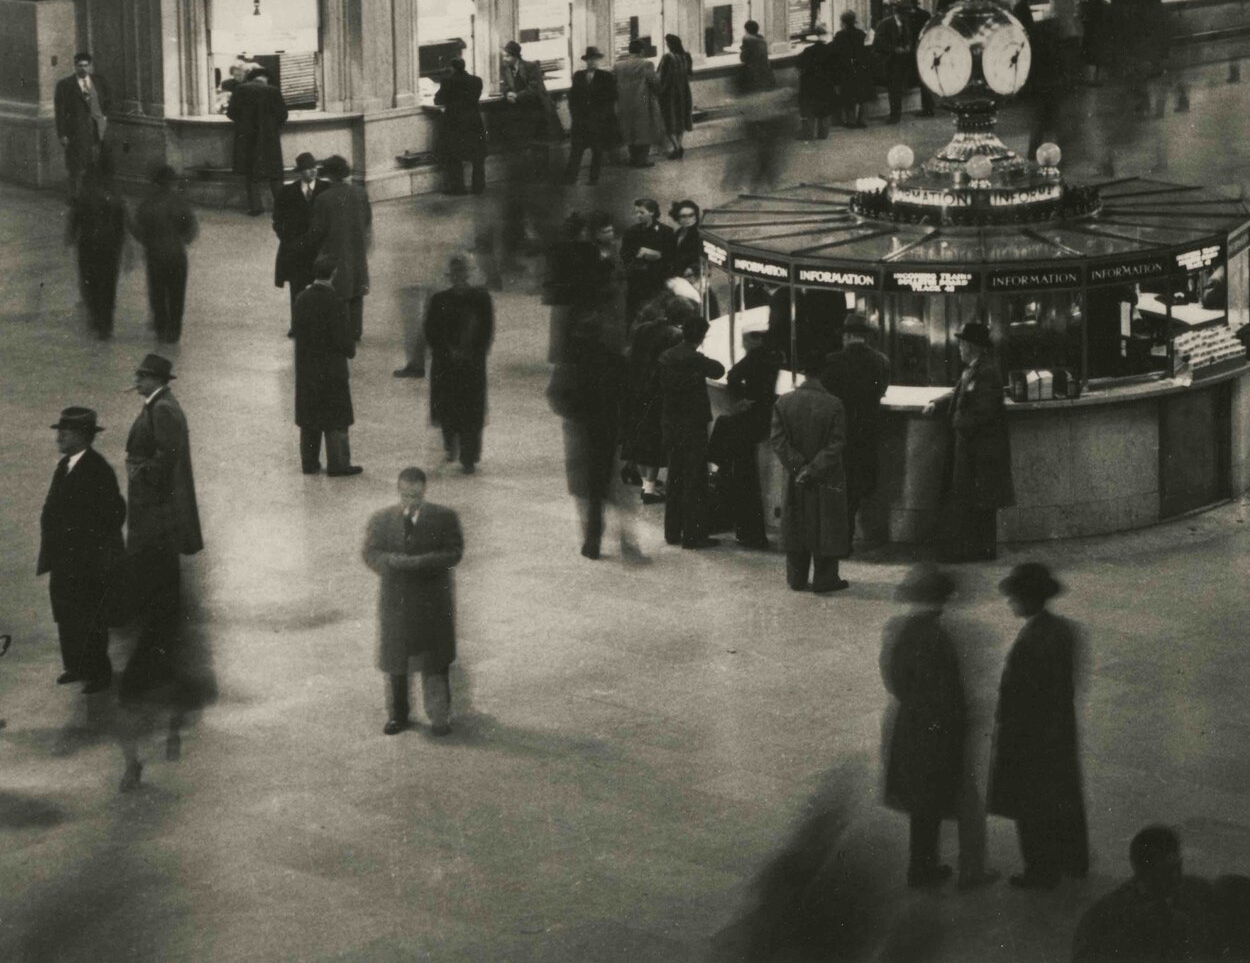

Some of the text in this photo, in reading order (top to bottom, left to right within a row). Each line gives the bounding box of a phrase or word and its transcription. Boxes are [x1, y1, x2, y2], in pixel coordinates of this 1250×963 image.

[734, 258, 788, 278] INFORMATION
[1091, 262, 1163, 280] INFORMATION
[799, 269, 875, 286] INFORMATION
[992, 272, 1077, 287] INFORMATION
